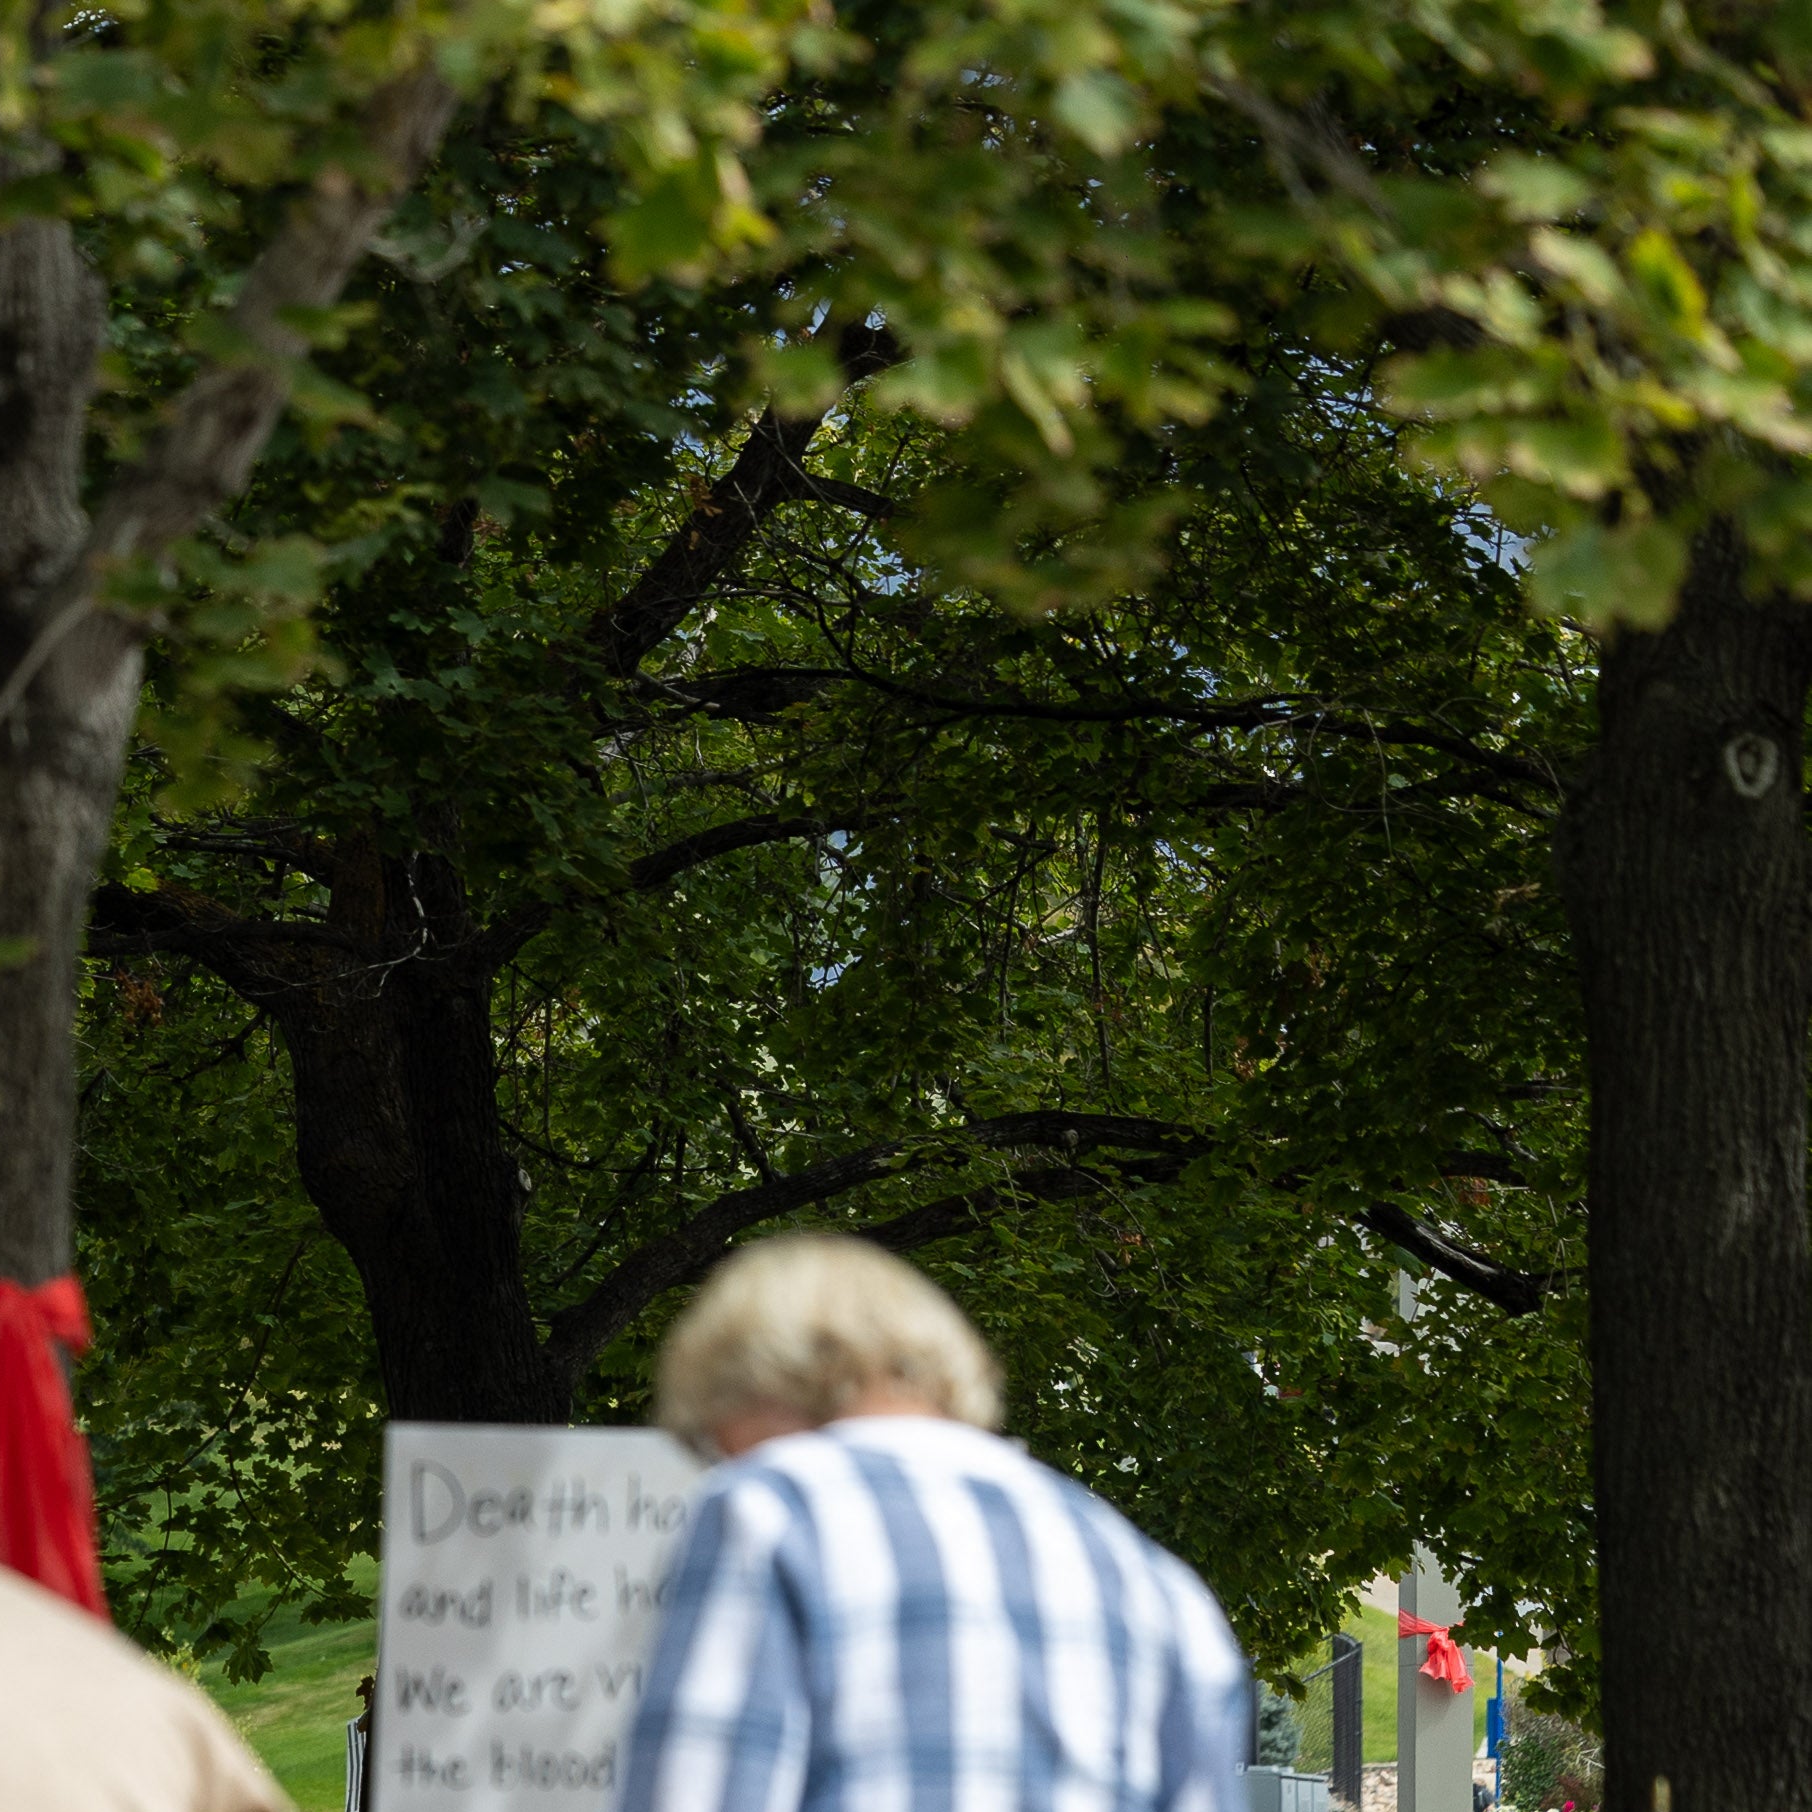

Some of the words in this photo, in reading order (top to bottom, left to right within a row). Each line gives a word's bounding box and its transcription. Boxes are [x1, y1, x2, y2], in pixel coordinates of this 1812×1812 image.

[410, 1456, 609, 1546] Death
[398, 1575, 492, 1628] and
[515, 1562, 596, 1622] life
[491, 1666, 581, 1712] are
[396, 1742, 471, 1788] the
[491, 1745, 616, 1793] blood
